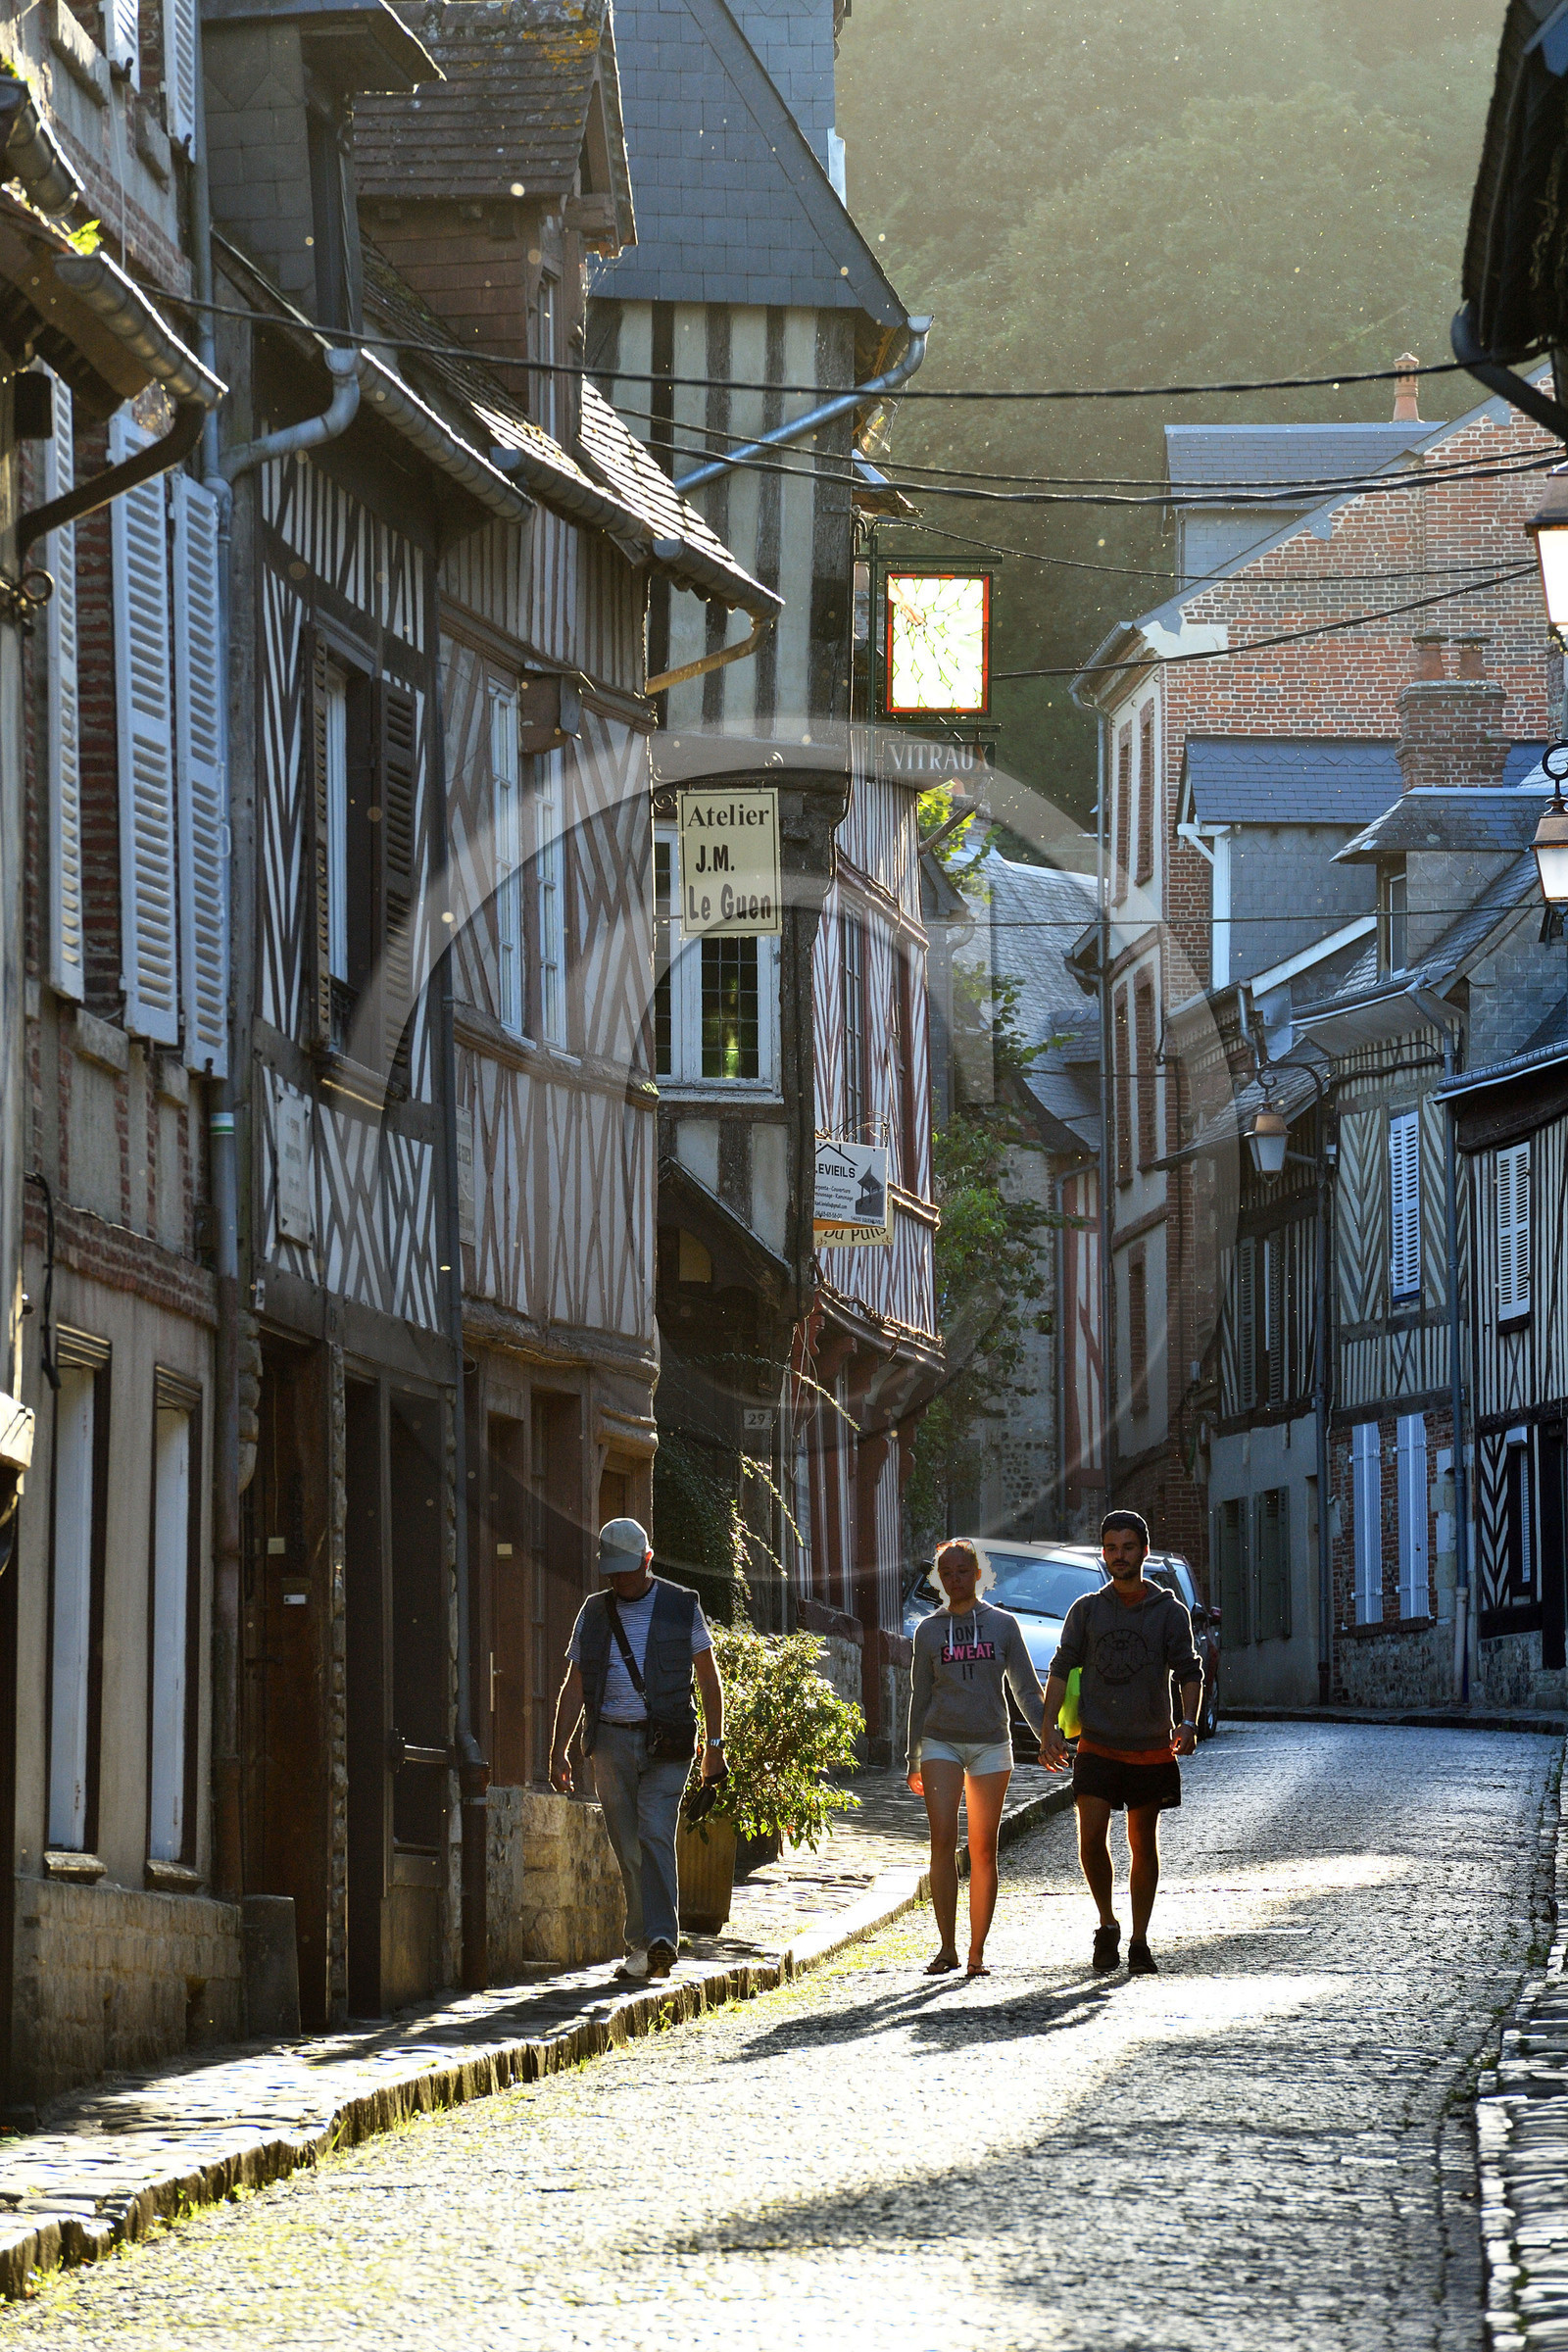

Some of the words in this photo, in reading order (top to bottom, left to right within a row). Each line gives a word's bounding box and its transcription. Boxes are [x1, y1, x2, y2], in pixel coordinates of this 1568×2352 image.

[889, 744, 991, 770] VITRAUX
[687, 804, 769, 827] Atelier
[695, 844, 735, 873] J.M.
[689, 885, 710, 920] Le
[720, 883, 771, 920] Guen
[815, 1163, 856, 1179] EVIEILS
[749, 1413, 765, 1425] 29
[943, 1642, 992, 1662] SWEAT
[962, 1663, 975, 1680] IT
